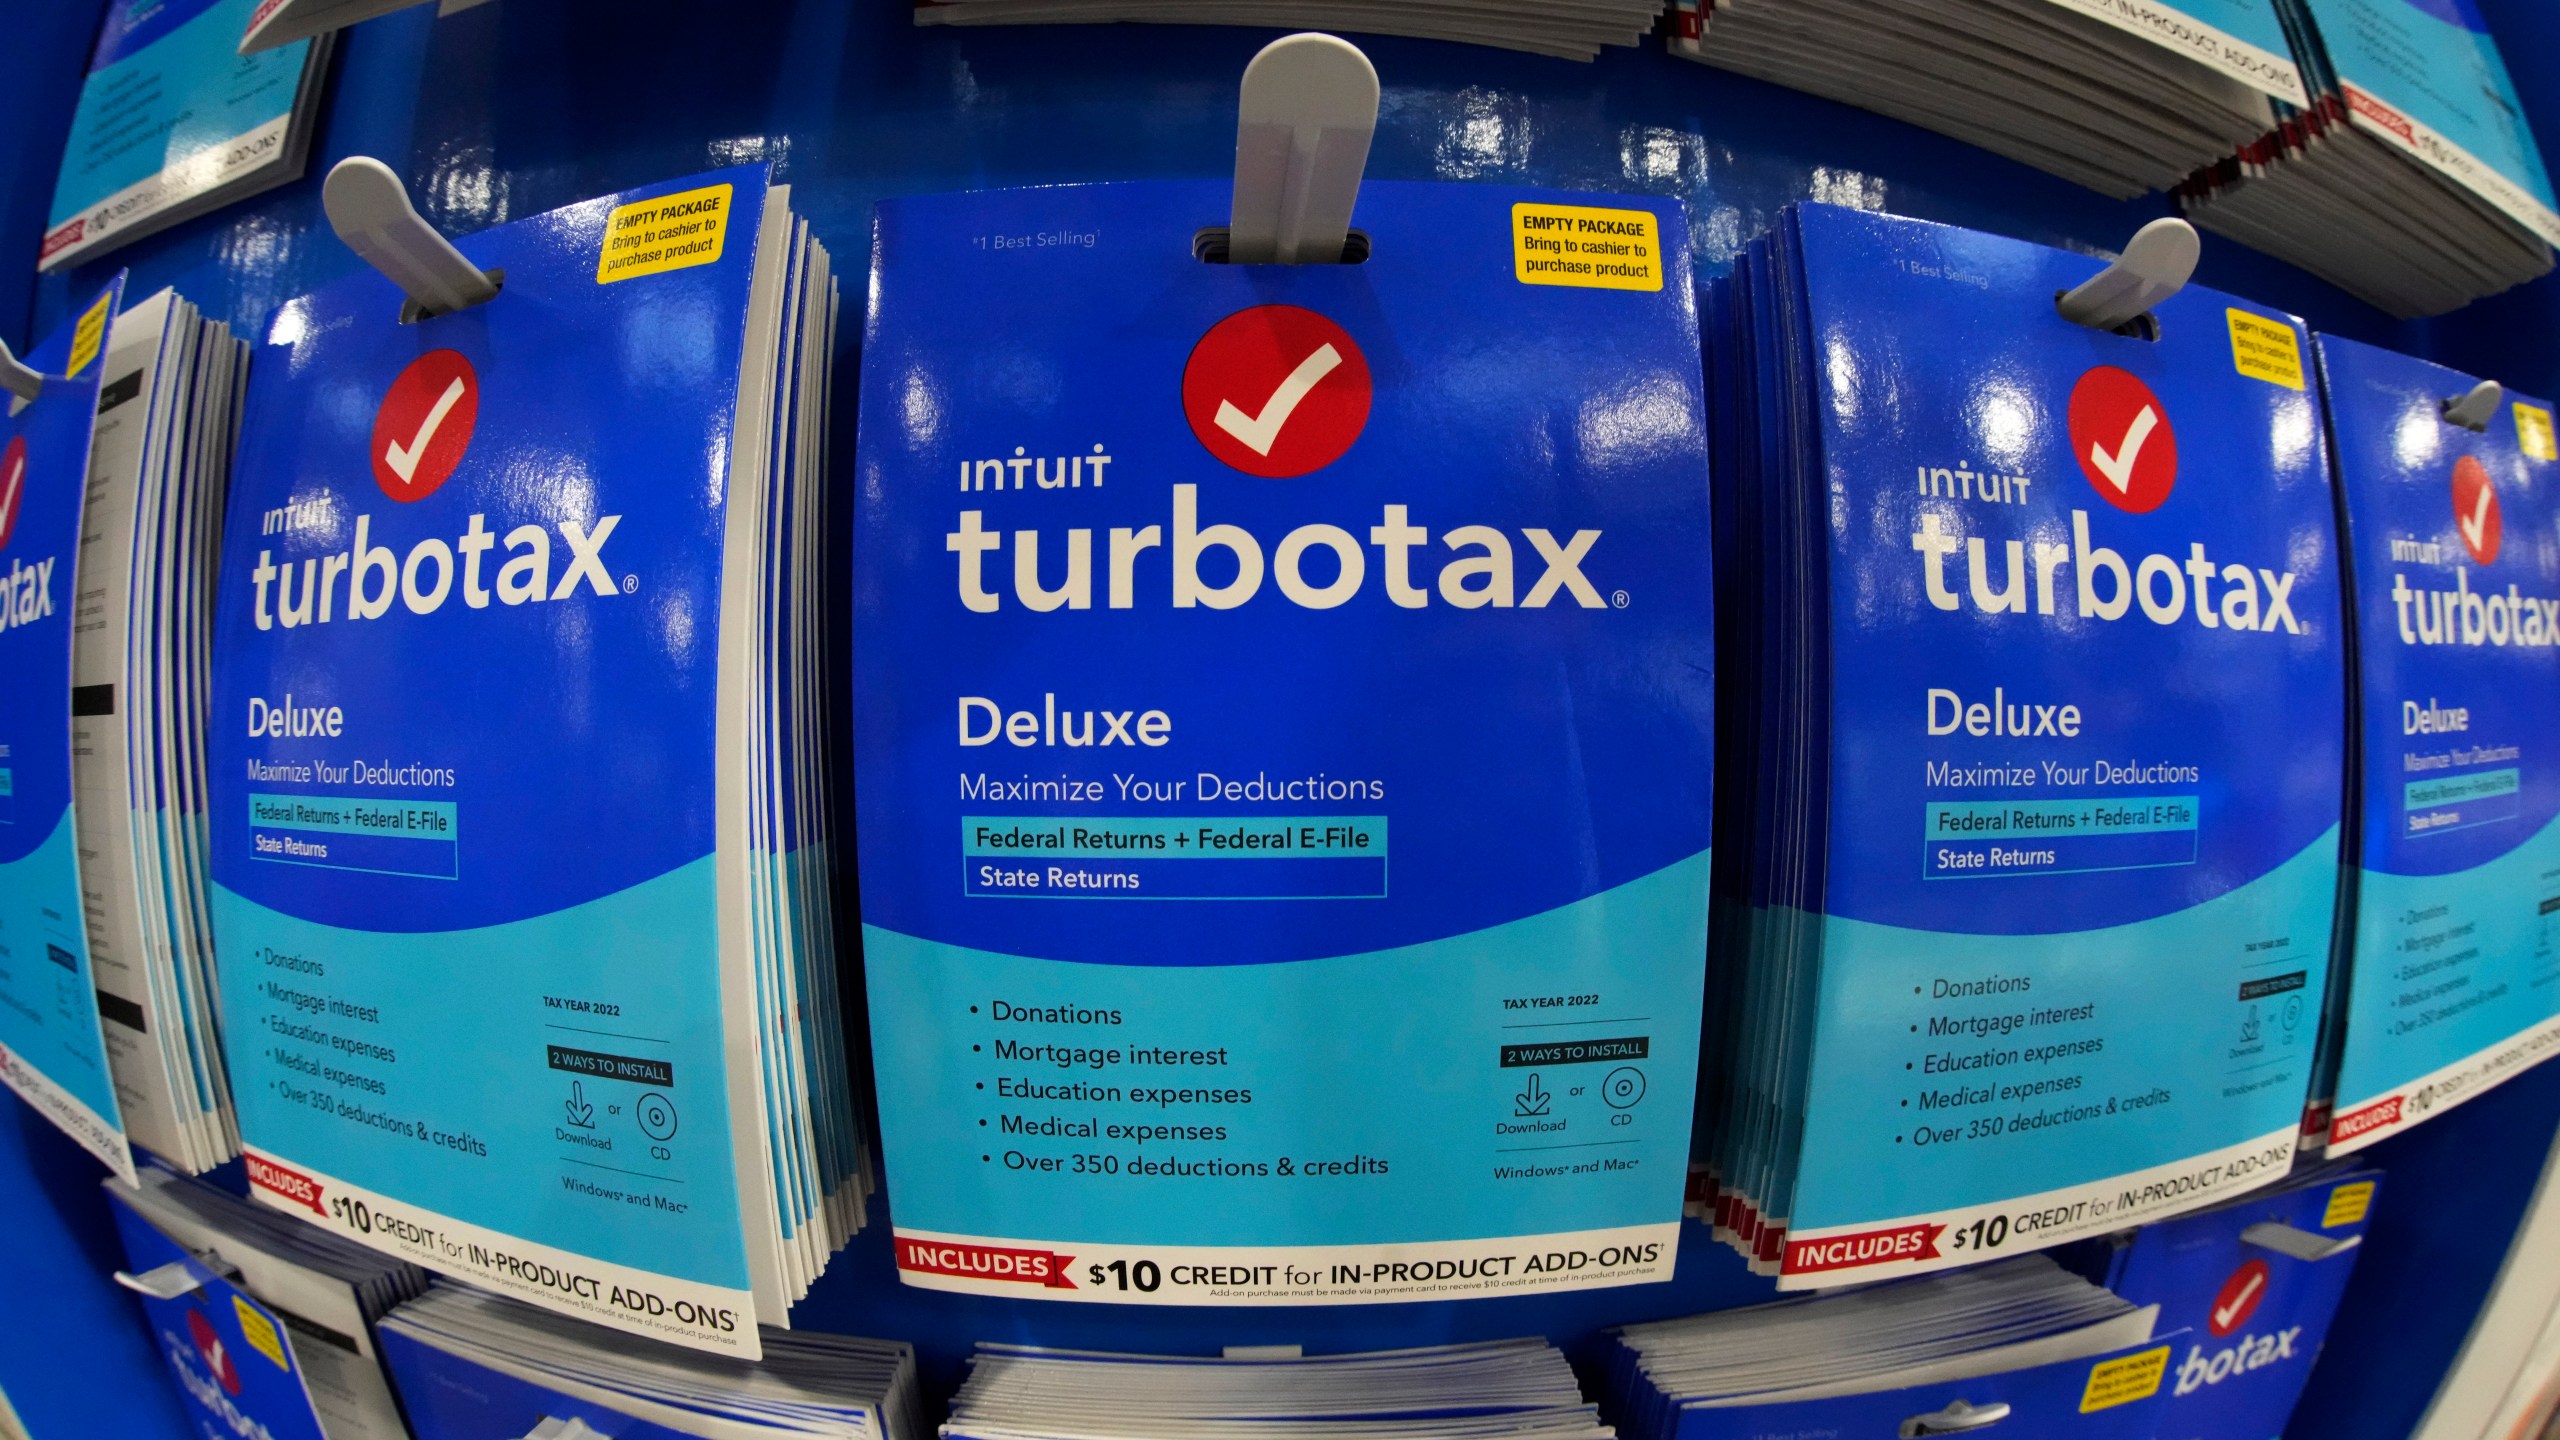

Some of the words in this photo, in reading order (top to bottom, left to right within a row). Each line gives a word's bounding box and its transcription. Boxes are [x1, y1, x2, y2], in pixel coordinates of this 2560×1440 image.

[616, 210, 658, 231] EMPTY
[661, 197, 720, 220] PACKAGE
[1523, 216, 1573, 231] EMPTY
[1578, 220, 1645, 236] PACKAGE
[612, 234, 640, 250] Bring
[644, 229, 655, 243] to
[658, 222, 702, 240] cashier
[705, 219, 716, 230] to
[994, 235, 1031, 249] Best
[1525, 236, 1561, 254] Bring
[1565, 239, 1577, 252] to
[1582, 241, 1630, 256] cashier
[1635, 244, 1646, 257] to
[607, 250, 661, 273] purchase
[665, 238, 713, 261] product
[1526, 259, 1591, 273] purchase
[1596, 263, 1649, 278] product
[248, 694, 343, 737] Deluxe
[959, 693, 1171, 748] Deluxe
[1927, 687, 2081, 737] Deluxe
[2403, 698, 2468, 735] Deluxe
[247, 759, 311, 782] Maximize
[314, 760, 349, 783] Your
[353, 759, 455, 786] Deductions
[959, 772, 1104, 801] Maximize
[1113, 773, 1186, 801] Your
[1197, 772, 1384, 801] Deductions
[1926, 761, 2036, 787] Maximize
[2042, 760, 2088, 786] Your
[2095, 759, 2199, 785] Deductions
[255, 803, 294, 821] Federal
[297, 805, 340, 824] Returns
[355, 808, 403, 829] Federal
[407, 810, 447, 831] E-File
[1939, 810, 2008, 831] Federal
[2013, 810, 2075, 830] Returns
[2095, 807, 2149, 827] Federal
[2154, 804, 2190, 824] E-File
[256, 835, 283, 853] State
[285, 837, 328, 857] Returns
[976, 827, 1065, 849] Federal
[1073, 828, 1166, 849] Returns
[1198, 827, 1291, 849] Federal
[1300, 826, 1370, 849] E-File
[1937, 848, 1984, 869] State
[1990, 848, 2055, 867] Returns
[980, 865, 1040, 888] State
[1047, 866, 1140, 888] Returns
[264, 948, 324, 976] Donations
[1933, 974, 2030, 999] Donations
[267, 981, 326, 1014] Mortgage
[328, 995, 379, 1023] interest
[543, 996, 562, 1008] TAX
[563, 999, 590, 1012] YEAR
[593, 1003, 620, 1017] 2022
[992, 1000, 1122, 1026] Donations
[1503, 999, 1528, 1010] TAX
[1531, 997, 1564, 1008] YEAR
[1568, 994, 1599, 1006] 2022
[1928, 1012, 2024, 1038] Mortgage
[2030, 1002, 2095, 1026] interest
[271, 1015, 328, 1046] Education
[332, 1035, 396, 1062] expenses
[1508, 1051, 1515, 1062] 2
[1520, 1049, 1561, 1062] WAYS
[1565, 1047, 1584, 1058] TO
[1588, 1043, 1642, 1057] INSTALL
[553, 1052, 560, 1064] 2
[562, 1054, 595, 1069] WAYS
[597, 1059, 614, 1073] TO
[617, 1065, 667, 1081] INSTALL
[995, 1039, 1121, 1069] Mortgage
[1129, 1044, 1228, 1066] interest
[1924, 1048, 2018, 1074] Education
[2024, 1036, 2104, 1066] expenses
[274, 1048, 320, 1077] Medical
[324, 1067, 386, 1095] expenses
[997, 1077, 1121, 1103] Education
[1129, 1086, 1252, 1109] expenses
[1570, 1086, 1585, 1096] or
[1918, 1082, 1996, 1111] Medical
[2001, 1074, 2082, 1103] expenses
[279, 1081, 308, 1103] Over
[309, 1091, 334, 1113] 350
[337, 1102, 414, 1139] deductions
[433, 1132, 487, 1157] credits
[608, 1105, 621, 1115] or
[1611, 1114, 1632, 1126] CD
[1913, 1124, 1963, 1146] Over
[1966, 1117, 2004, 1139] 350
[2008, 1102, 2101, 1133] deductions
[2121, 1087, 2171, 1112] credits
[2336, 1100, 2397, 1139] INCLUDES
[556, 1128, 612, 1150] Download
[1000, 1114, 1098, 1138] Medical
[1106, 1123, 1227, 1145] expenses
[1496, 1119, 1566, 1134] Download
[651, 1146, 671, 1161] CD
[1003, 1150, 1065, 1173] Over
[1072, 1154, 1119, 1174] 350
[1127, 1155, 1269, 1177] deductions
[1304, 1154, 1389, 1176] credits
[1572, 1160, 1599, 1173] and
[247, 1158, 313, 1202] INCLUDES
[333, 1197, 370, 1234] $10
[374, 1213, 435, 1249] CREDIT
[439, 1233, 463, 1259] for
[468, 1243, 600, 1300] IN-PRODUCT
[1797, 1231, 1924, 1267] INCLUDES
[1953, 1215, 2008, 1250] $10
[2014, 1202, 2087, 1234] CREDIT
[2089, 1197, 2113, 1219] for
[2117, 1166, 2222, 1211] IN-PRODUCT
[908, 1245, 1049, 1277] INCLUDES
[1089, 1260, 1161, 1293] $10
[1170, 1266, 1277, 1285] CREDIT
[1284, 1265, 1322, 1285] for
[1331, 1257, 1516, 1284] IN-PRODUCT
[1247, 1289, 1289, 1298] purchase
[1317, 1288, 1328, 1296] be
[1331, 1288, 1357, 1296] made
[1359, 1287, 1372, 1295] via
[1374, 1286, 1414, 1295] payment
[1450, 1282, 1481, 1290] receive
[1484, 1279, 1499, 1289] $10
[1501, 1277, 1526, 1287] credit
[1539, 1276, 1558, 1284] time
[1571, 1271, 1615, 1282] in-product
[1617, 1267, 1655, 1277] purchase
[2173, 1325, 2302, 1397] botax
